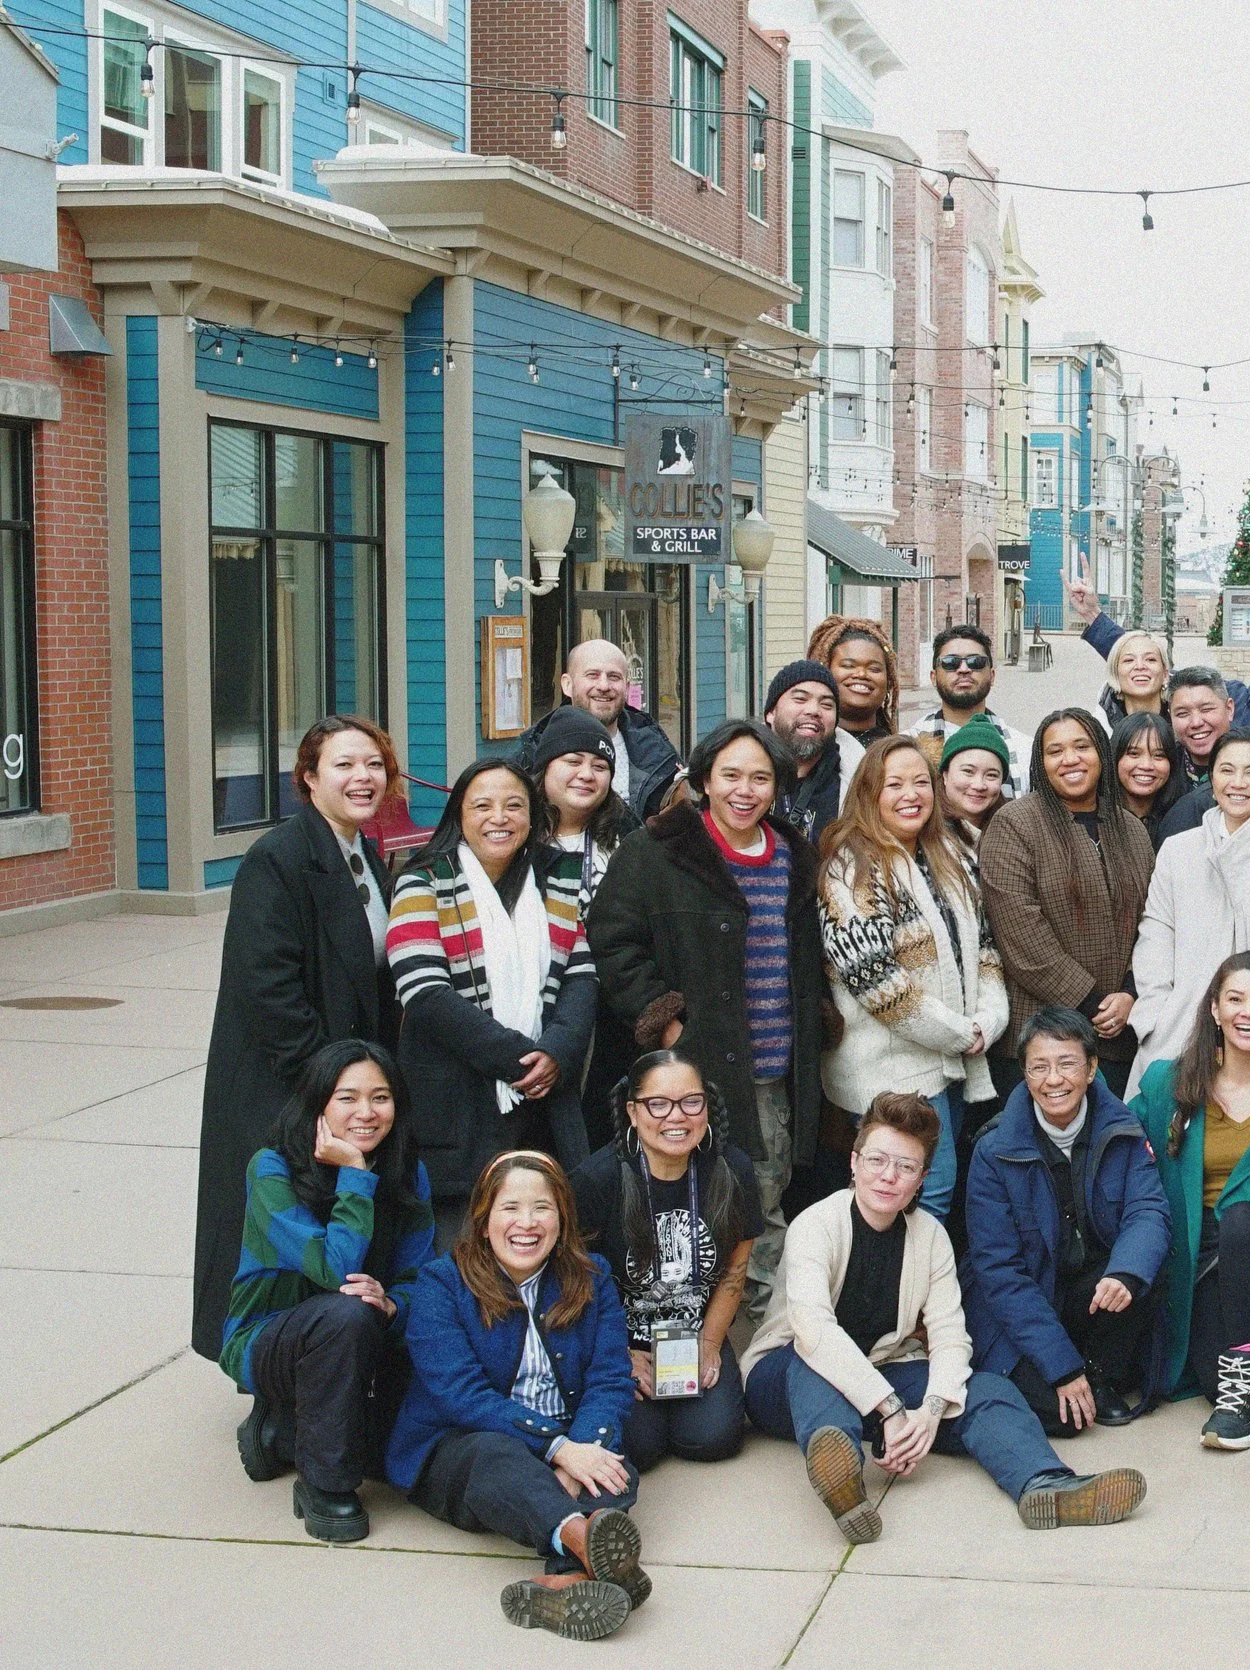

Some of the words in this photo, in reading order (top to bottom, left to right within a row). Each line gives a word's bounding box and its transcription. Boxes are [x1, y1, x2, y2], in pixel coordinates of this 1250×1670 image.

[631, 482, 724, 519] COLLIE'S
[636, 527, 688, 540] SPORTS
[690, 528, 717, 541] BAR
[651, 540, 661, 552] &
[665, 540, 702, 553] GRILL
[999, 560, 1030, 570] TROVE
[599, 740, 614, 759] POV
